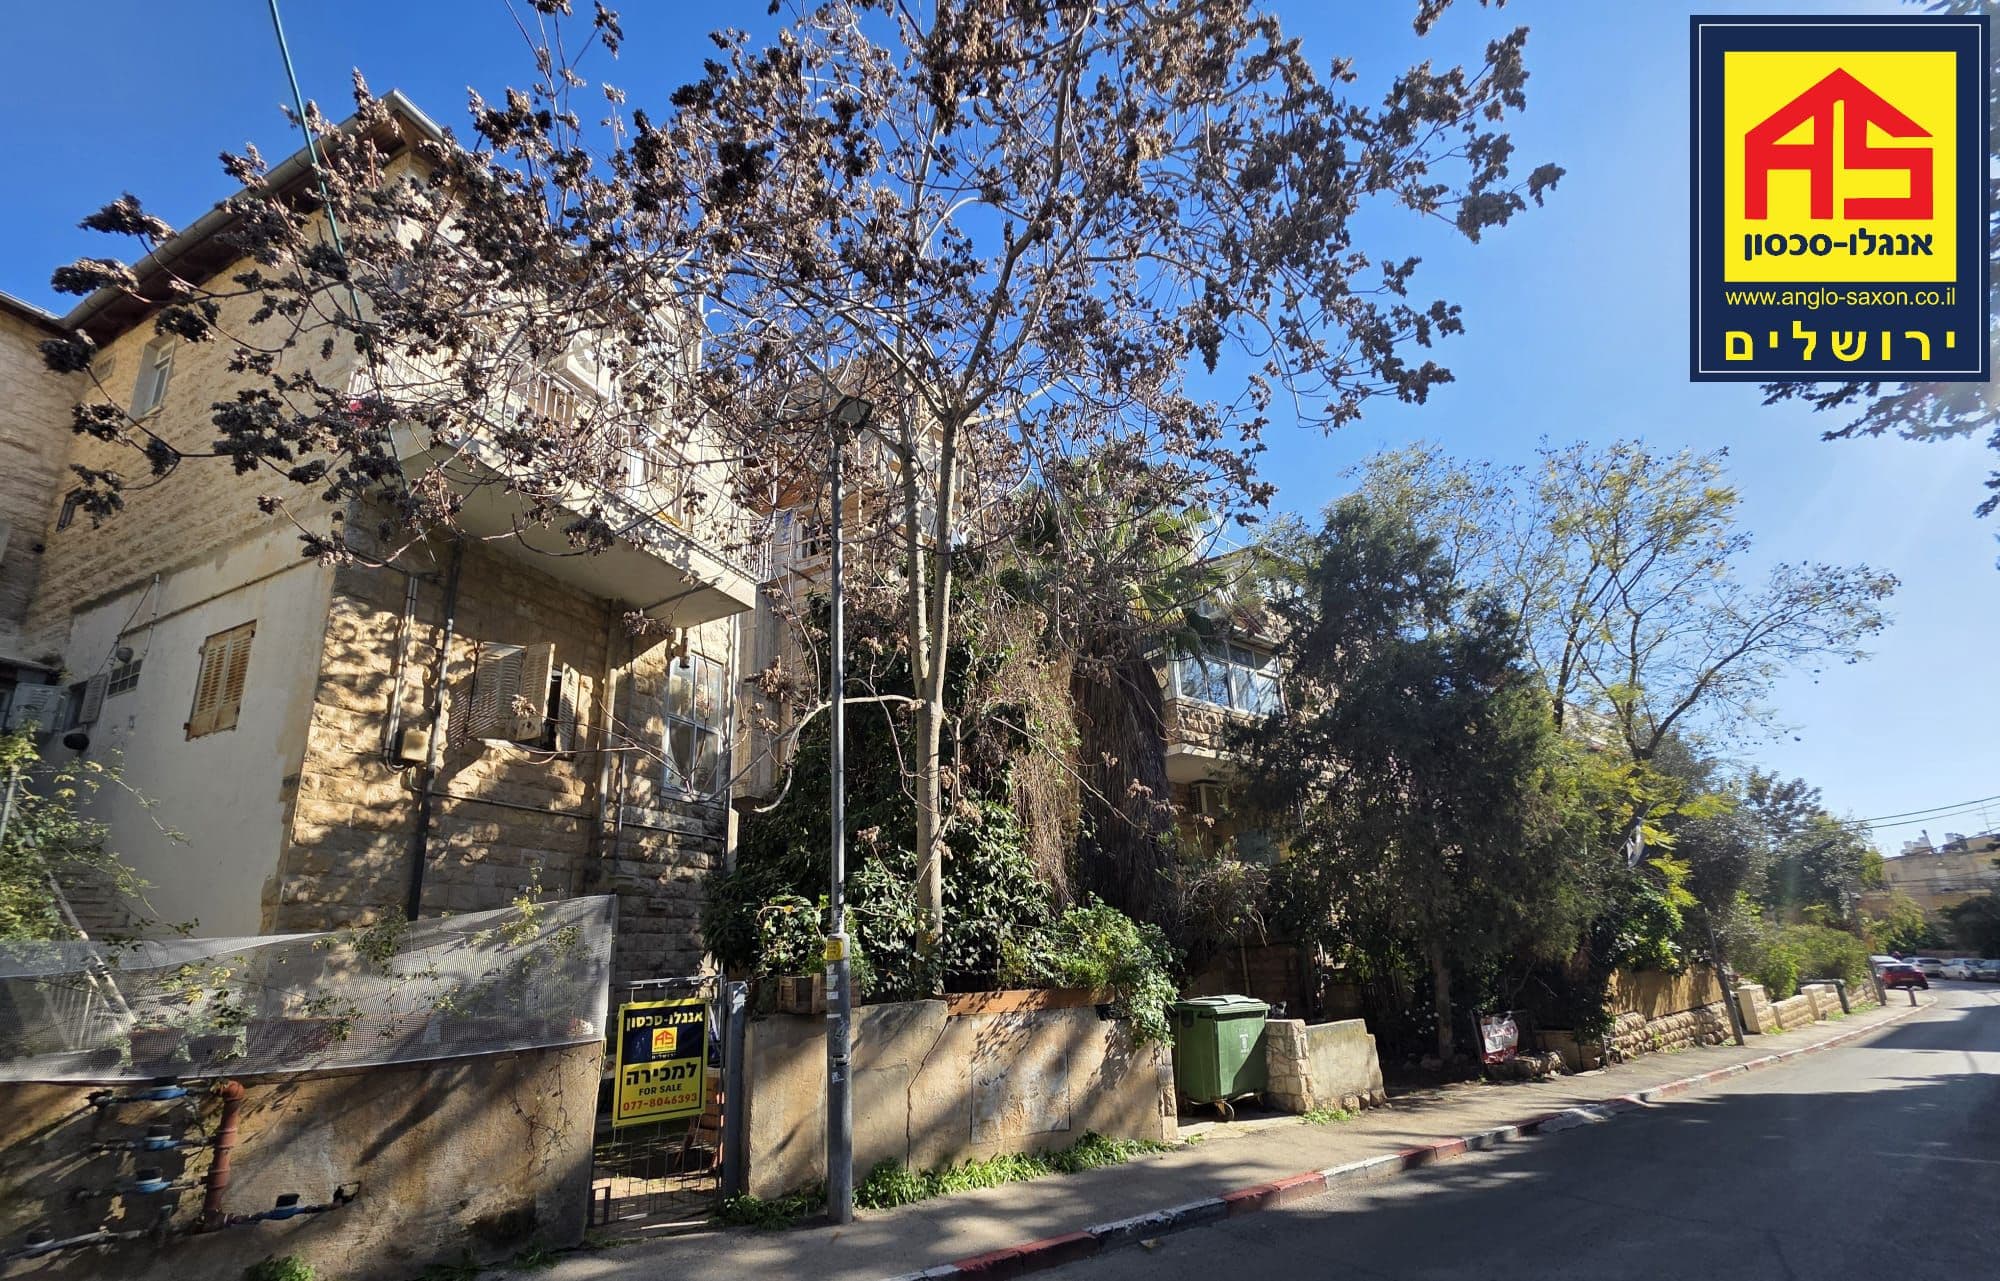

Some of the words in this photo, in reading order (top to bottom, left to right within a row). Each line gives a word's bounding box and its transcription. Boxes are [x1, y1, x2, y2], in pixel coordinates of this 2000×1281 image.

[626, 1011, 703, 1032] אנגלו-סכסון
[626, 1062, 698, 1086] למכירה
[638, 1086, 657, 1096] FOR
[659, 1083, 682, 1094] SALE
[623, 1093, 698, 1111] 077-8046393
